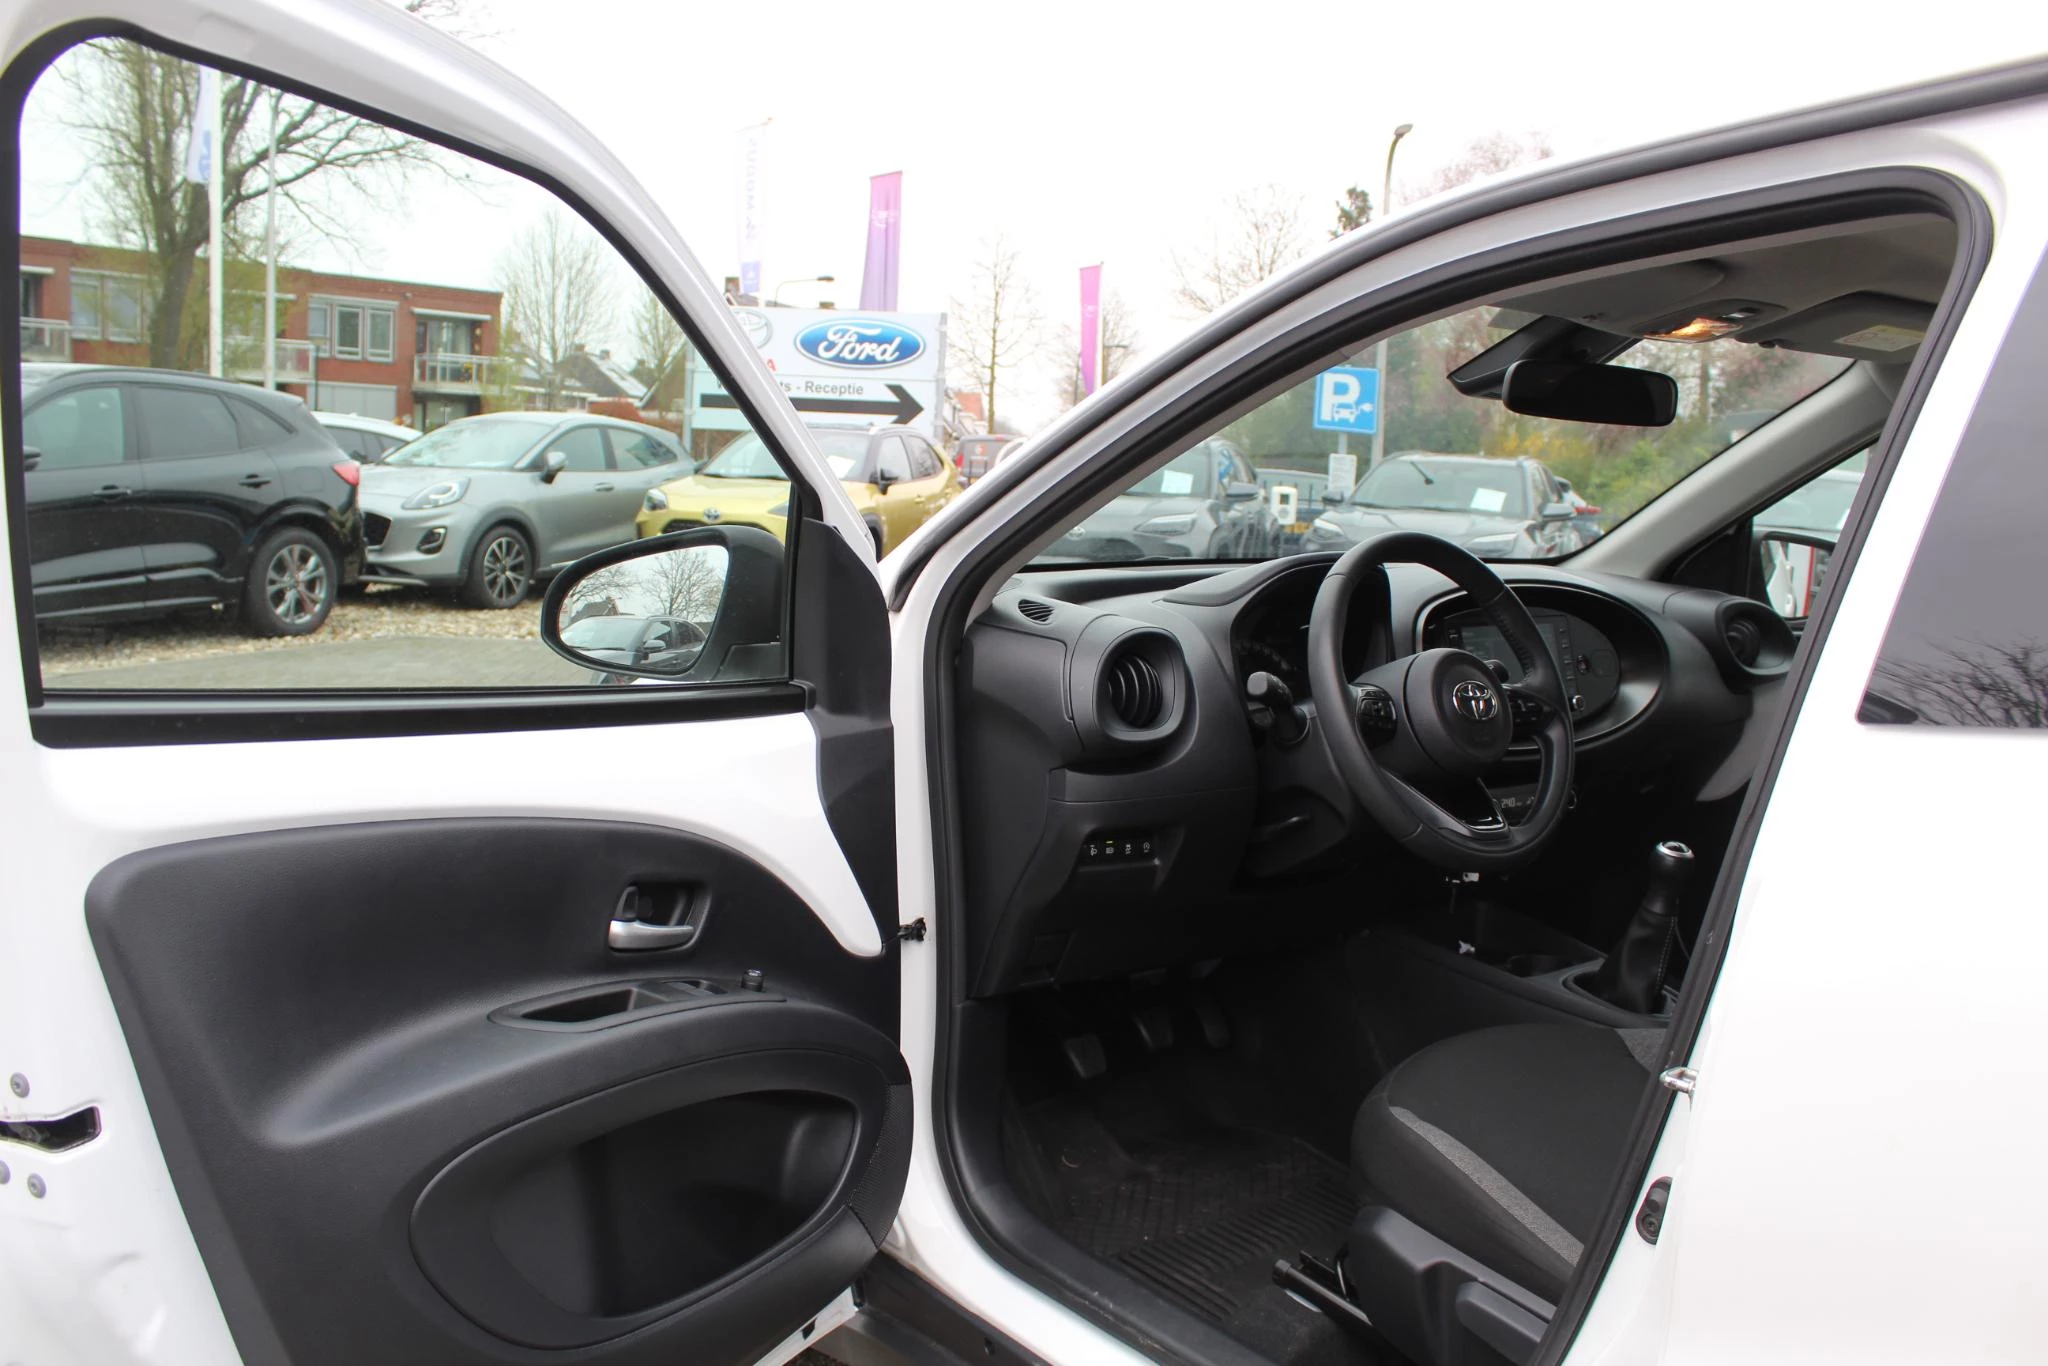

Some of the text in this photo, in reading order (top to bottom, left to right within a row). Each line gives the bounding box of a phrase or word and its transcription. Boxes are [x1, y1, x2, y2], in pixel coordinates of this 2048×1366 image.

[818, 325, 902, 361] Ford
[805, 380, 864, 397] Receptie
[1320, 373, 1360, 421] P
